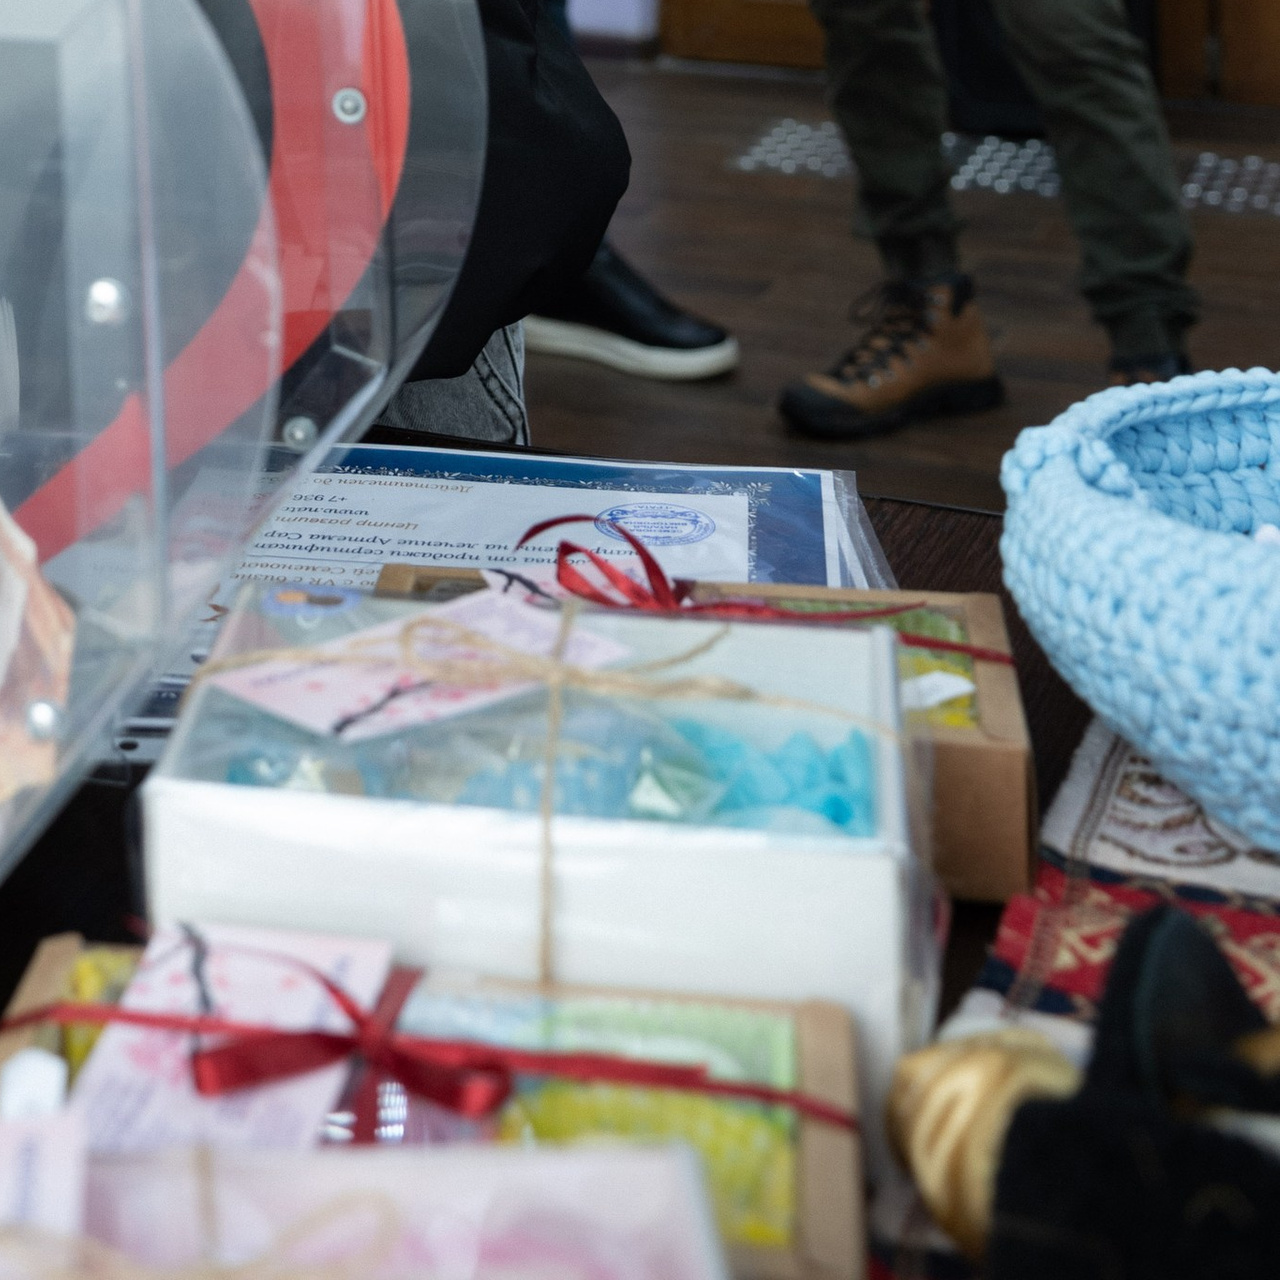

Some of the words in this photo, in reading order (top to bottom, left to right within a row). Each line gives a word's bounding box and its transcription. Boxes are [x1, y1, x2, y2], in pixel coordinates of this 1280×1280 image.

[337, 477, 474, 494] Действителен
[356, 516, 420, 531] Центр
[263, 529, 303, 542] Сар
[308, 532, 392, 547] Артема
[397, 538, 479, 550] лечение
[484, 543, 509, 553] на
[389, 549, 480, 563] продажи
[486, 553, 518, 564] от
